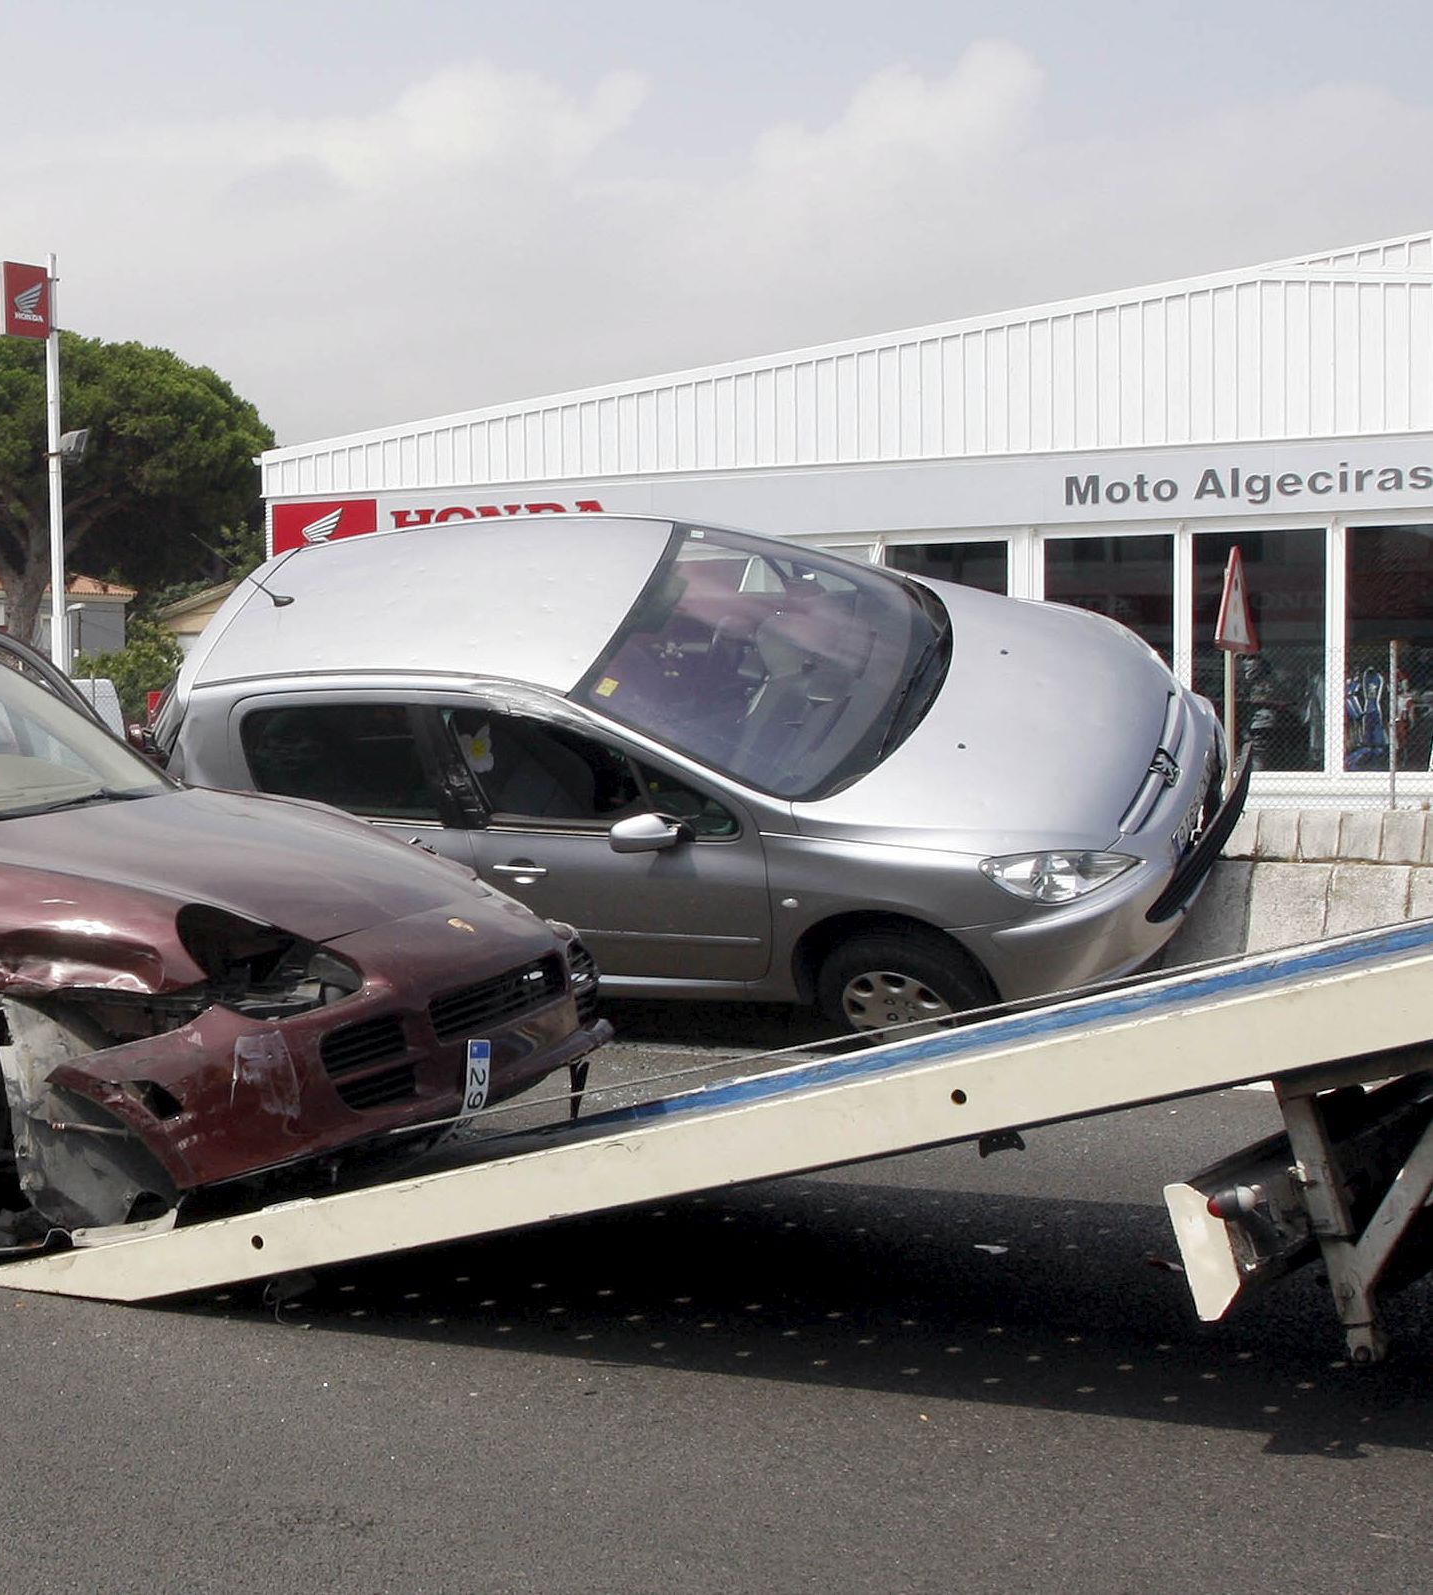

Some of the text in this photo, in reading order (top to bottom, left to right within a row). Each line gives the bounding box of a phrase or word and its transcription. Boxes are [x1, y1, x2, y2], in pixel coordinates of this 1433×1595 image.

[14, 311, 44, 323] HONDA
[1065, 462, 1433, 505] Moto Algeciras
